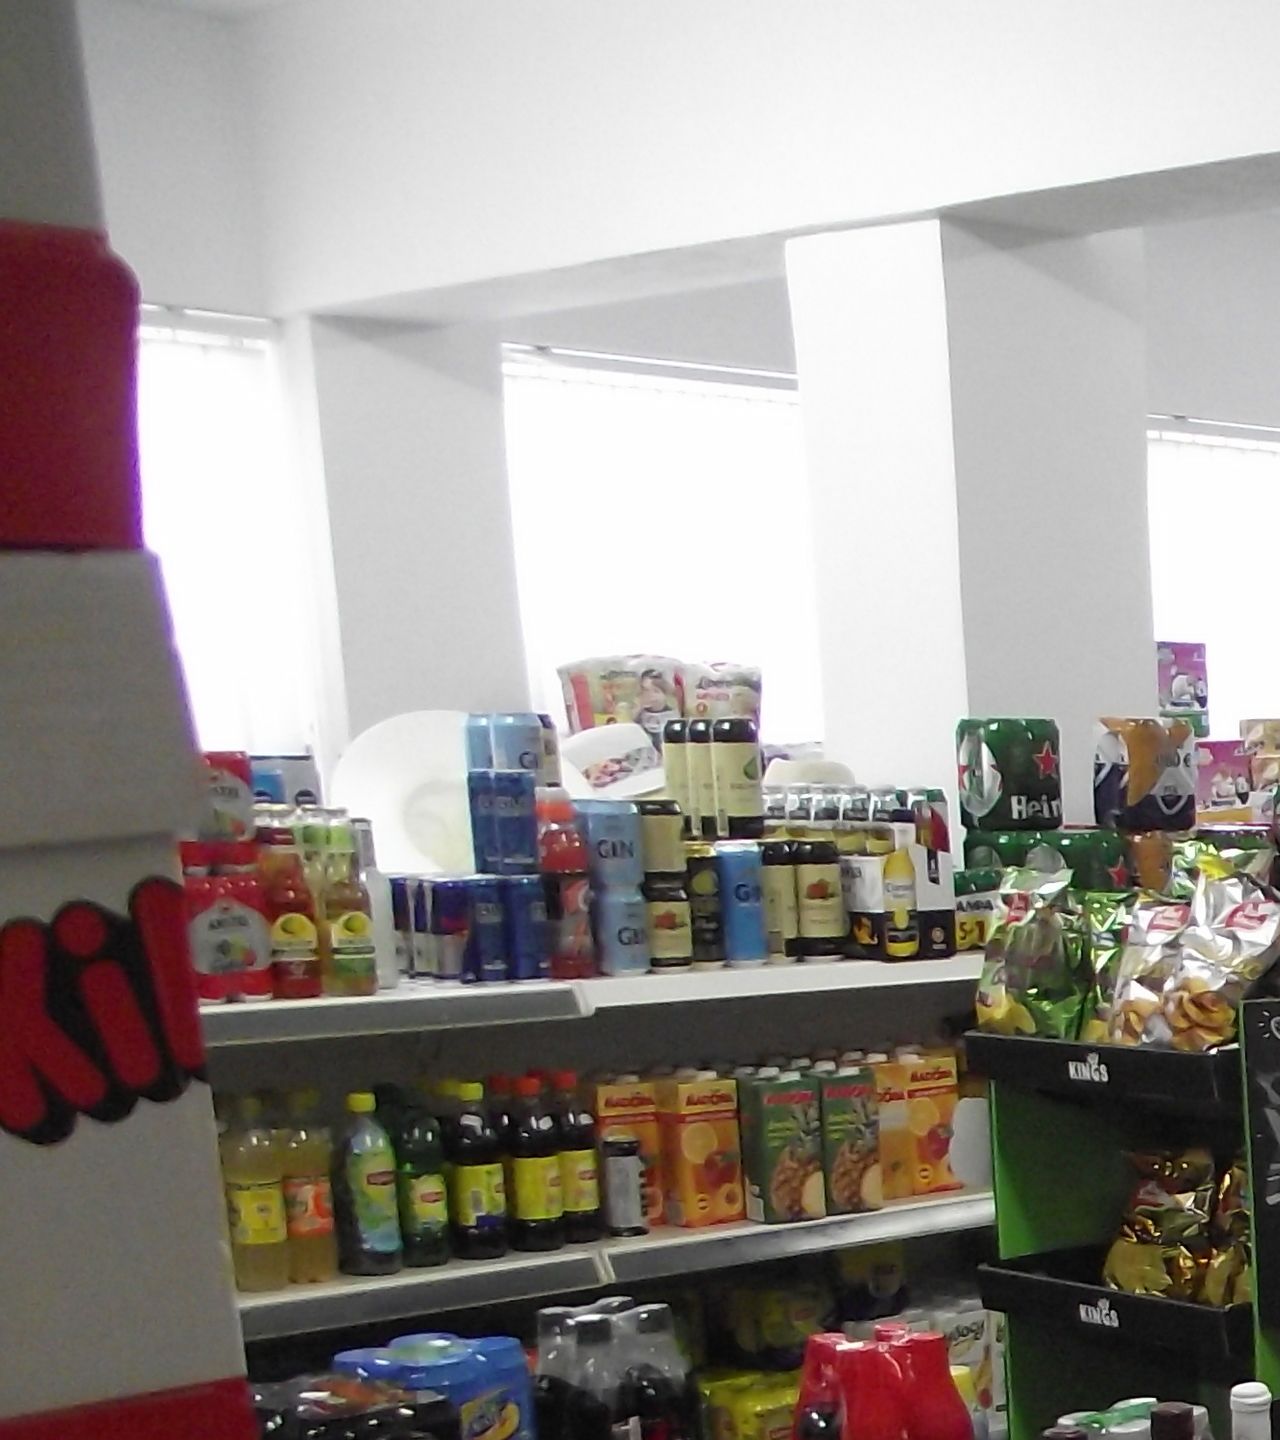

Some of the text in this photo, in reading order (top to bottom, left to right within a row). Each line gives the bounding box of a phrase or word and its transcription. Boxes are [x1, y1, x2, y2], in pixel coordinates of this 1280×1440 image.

[1010, 794, 1063, 820] Hein
[597, 839, 634, 859] GIN
[1068, 1060, 1109, 1083] KINGS
[1079, 1303, 1120, 1328] KINGS
